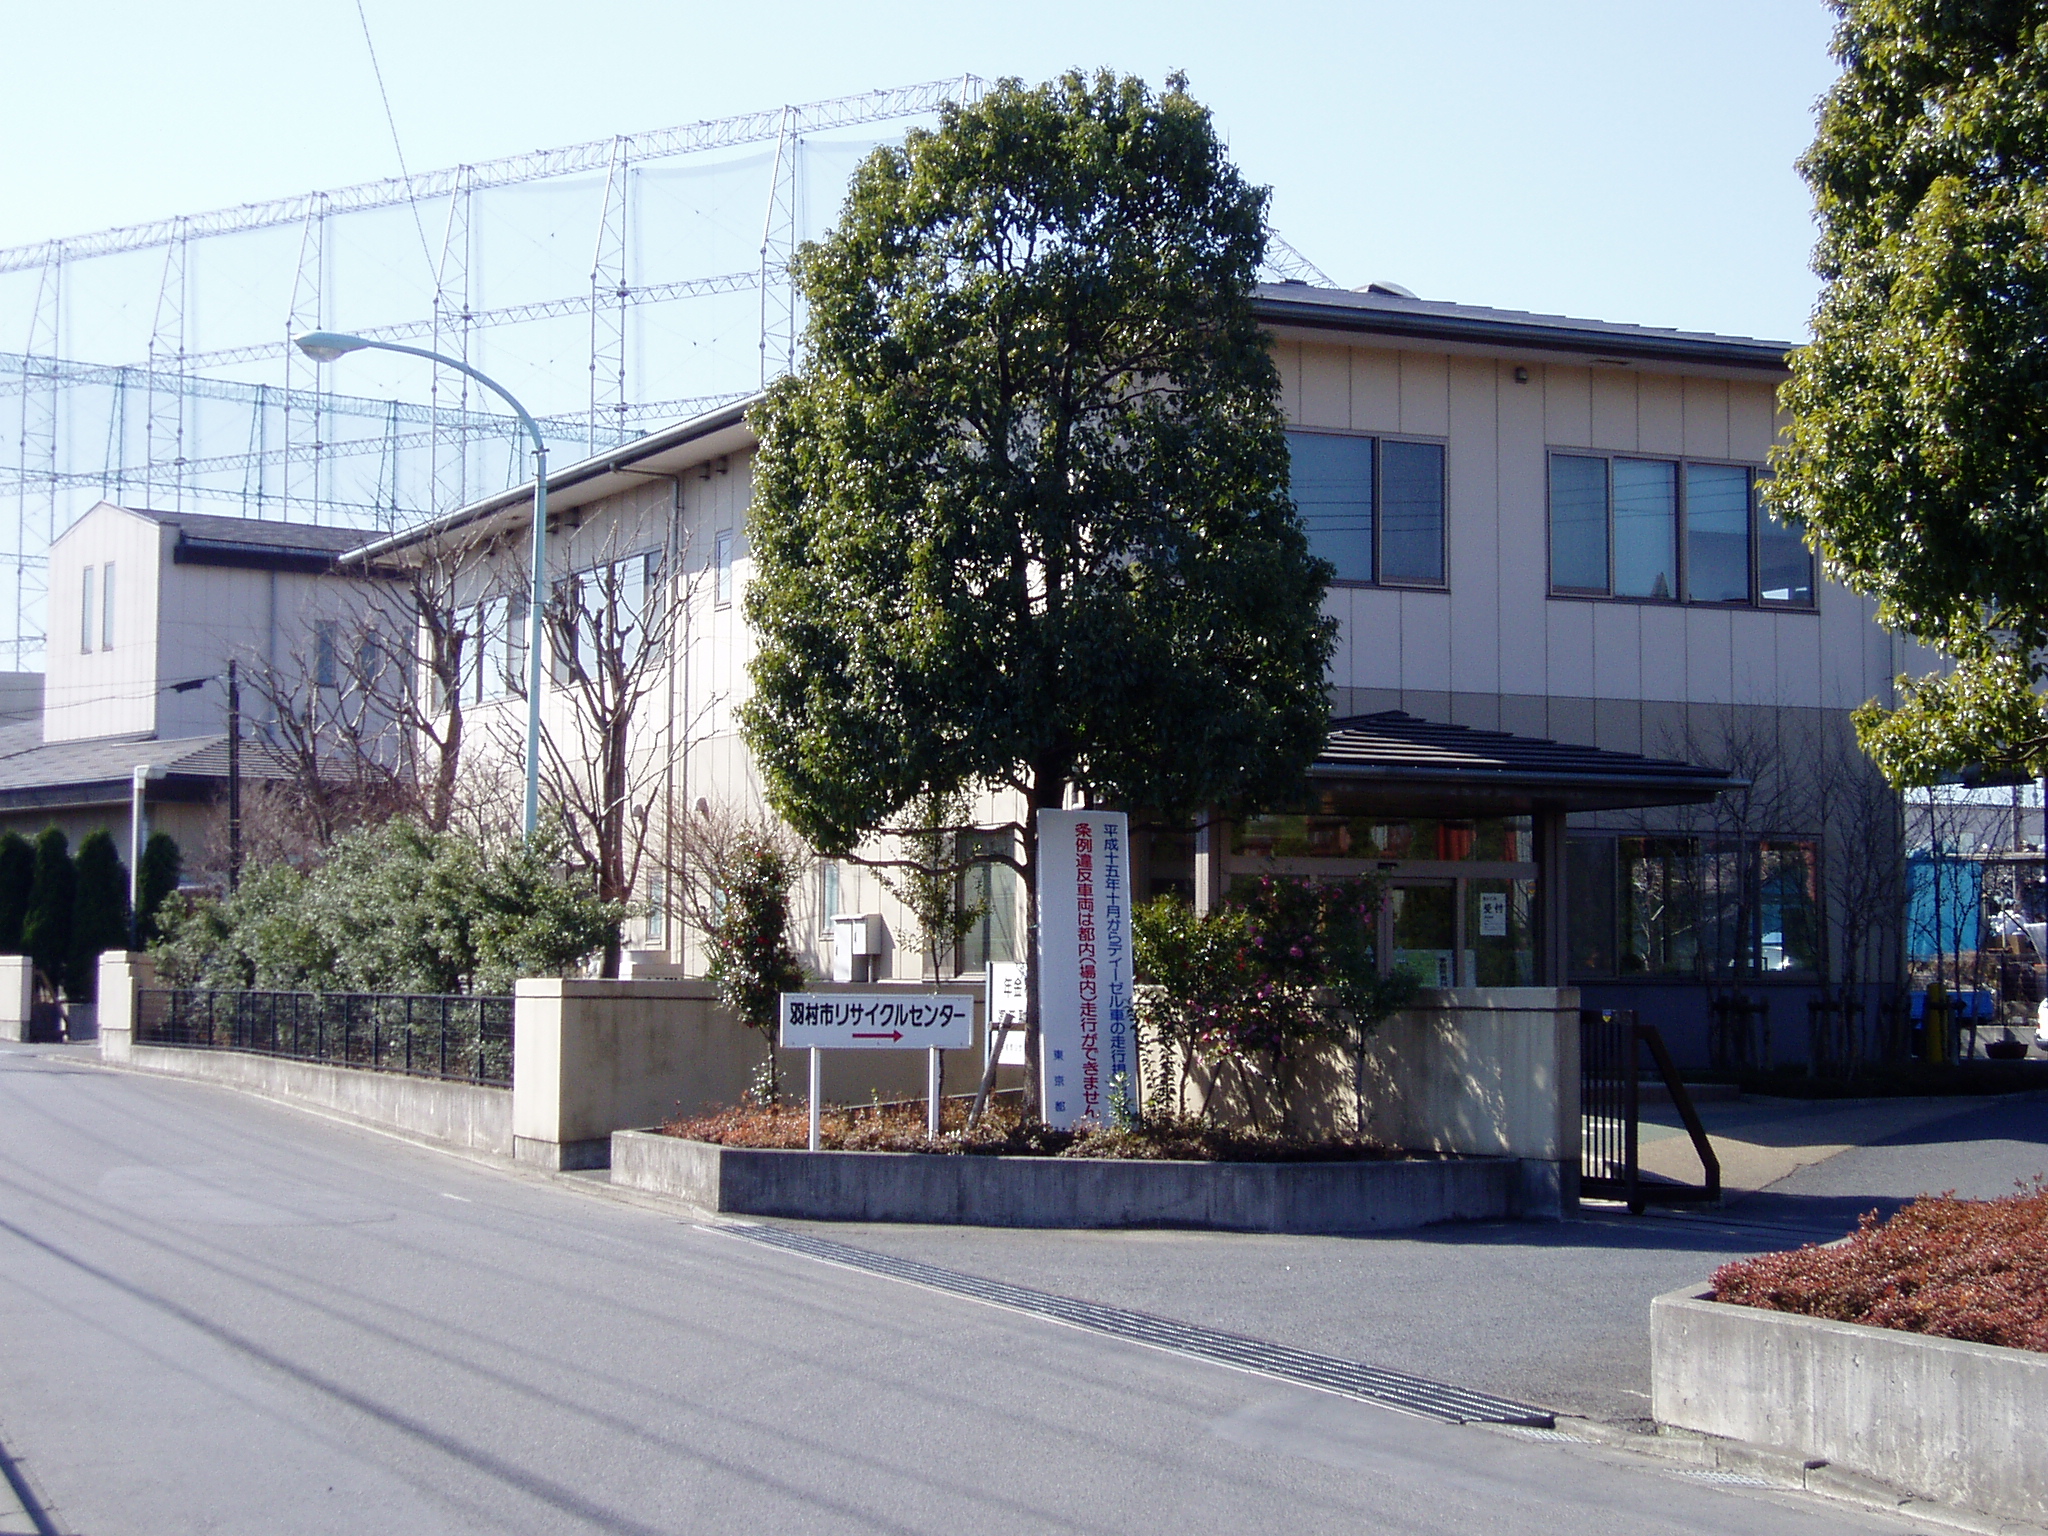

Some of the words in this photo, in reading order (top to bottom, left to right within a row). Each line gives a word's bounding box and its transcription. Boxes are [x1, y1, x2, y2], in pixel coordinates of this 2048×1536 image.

[790, 1002, 966, 1027] 羽村市リサイクルセンター
[1053, 1050, 1066, 1112] 東京都
